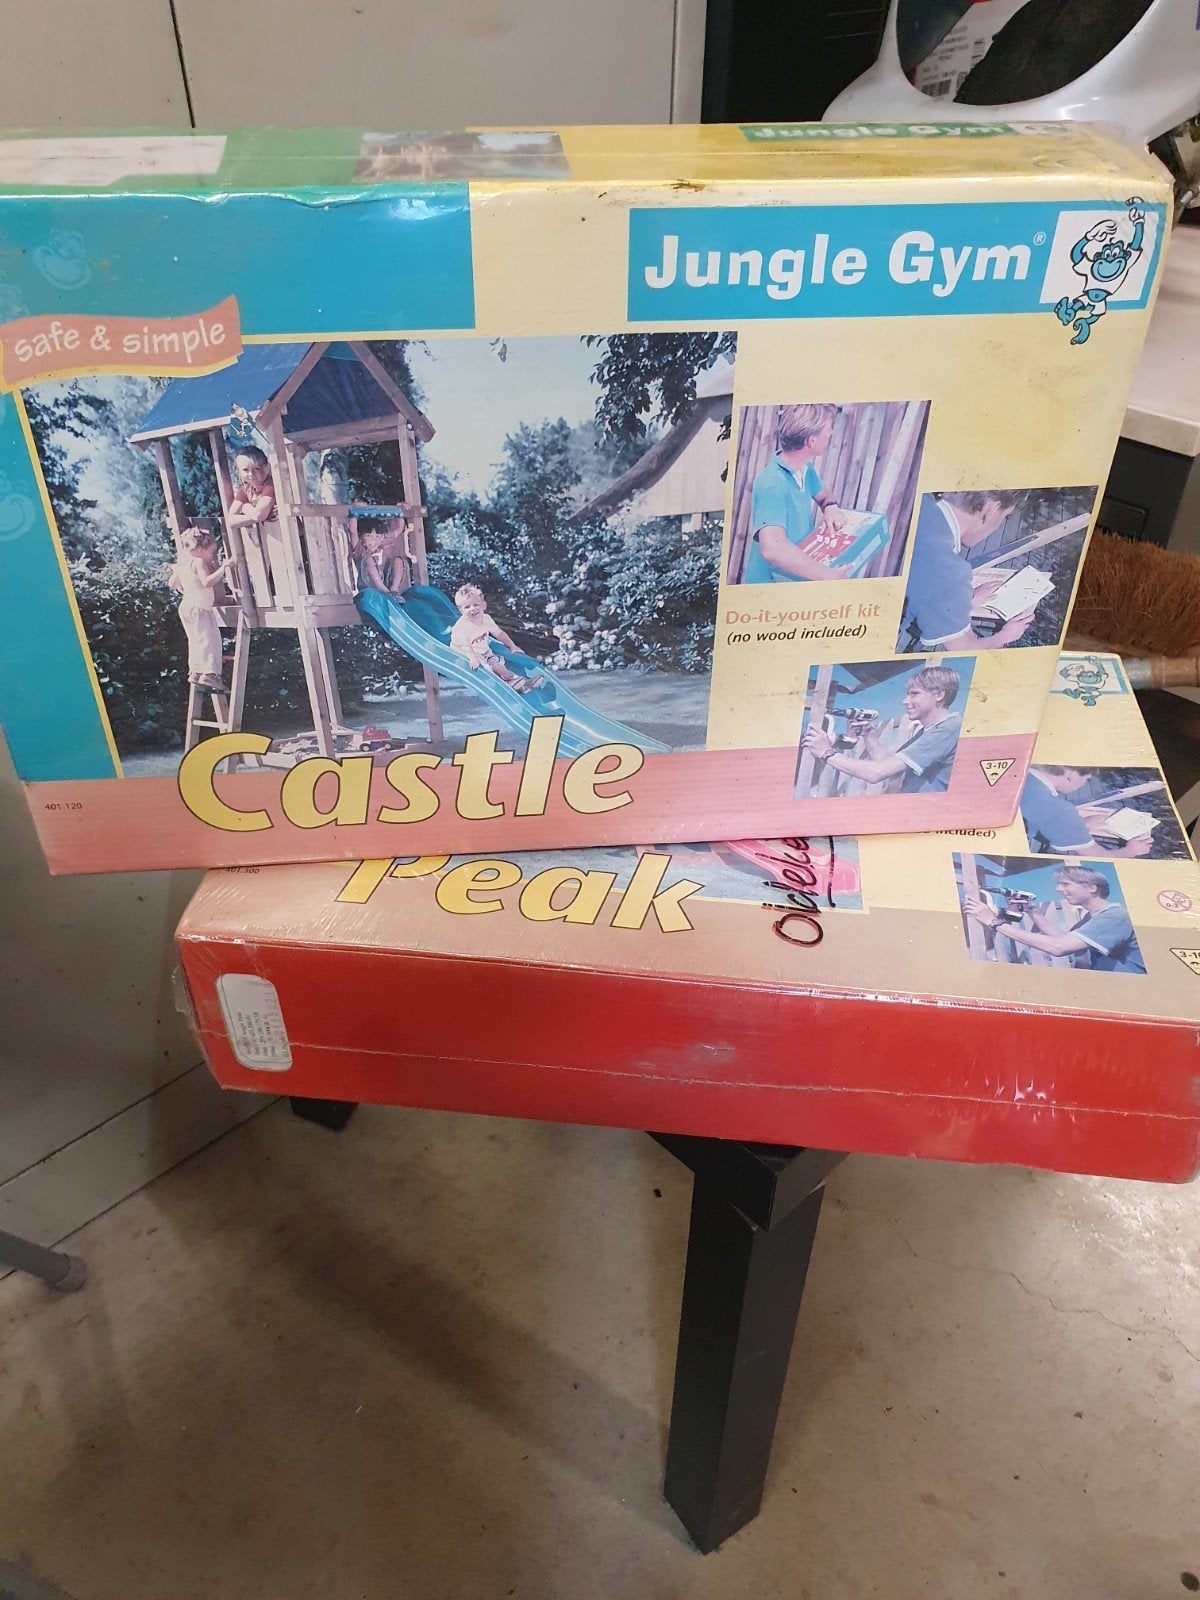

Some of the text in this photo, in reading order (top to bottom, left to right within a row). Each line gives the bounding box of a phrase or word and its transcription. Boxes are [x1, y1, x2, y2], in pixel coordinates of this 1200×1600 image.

[644, 233, 868, 300] Jungle
[14, 318, 226, 364] safe & simple
[725, 603, 881, 627] Do-it-yourself kit
[727, 624, 867, 646] (no wood included)
[177, 714, 645, 833] Castle
[985, 761, 1008, 770] 3-10
